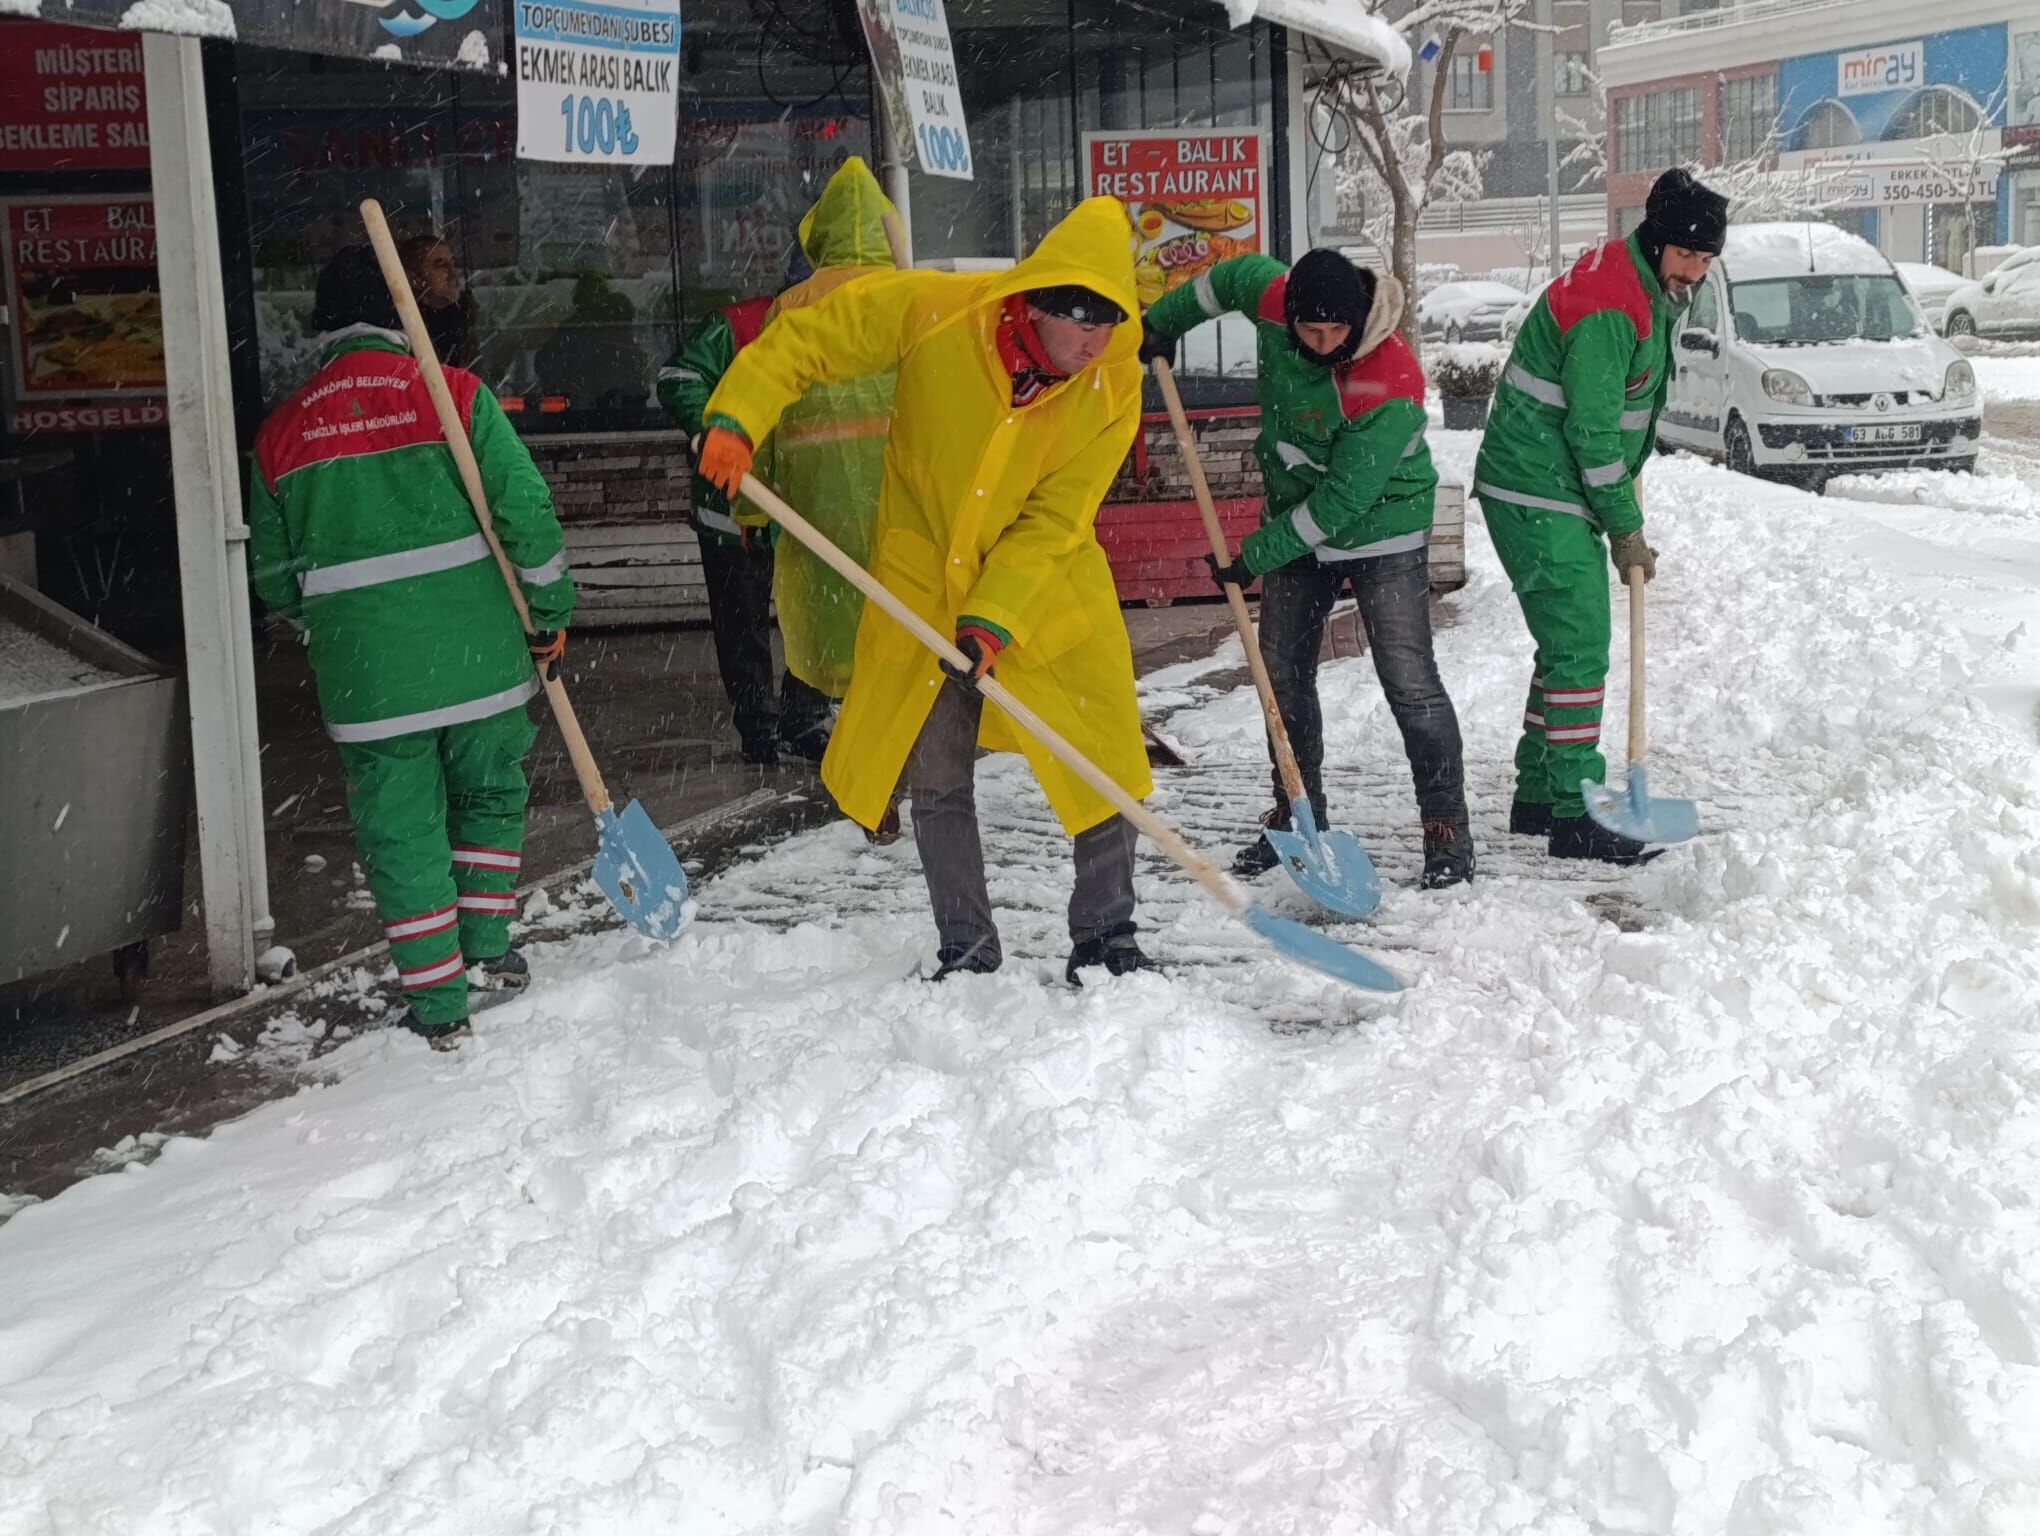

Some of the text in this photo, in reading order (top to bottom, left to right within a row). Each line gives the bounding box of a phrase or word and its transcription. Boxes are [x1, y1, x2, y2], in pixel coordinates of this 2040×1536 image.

[522, 5, 674, 48] TOPÇUMEYDANI ŞUBESİ
[35, 43, 142, 76] MÜŞTERİ
[520, 46, 671, 93] EKMEK ARASI BALIK
[1845, 51, 1915, 84] miray
[44, 81, 140, 112] SİPARİŞ
[922, 90, 949, 117] BALIK
[1103, 142, 1130, 166] ET
[1177, 138, 1246, 164] BALIK
[1097, 168, 1257, 196] RESTAURANT
[1890, 169, 1928, 180] ERKEK
[1978, 180, 1996, 195] TL
[24, 209, 53, 232] ET
[356, 375, 411, 391] BELEDİYESİ
[13, 407, 168, 431] HOŞGELD
[302, 423, 339, 441] TEMİZLİK
[1852, 428, 1866, 441] 63
[1901, 425, 1920, 439] 581
